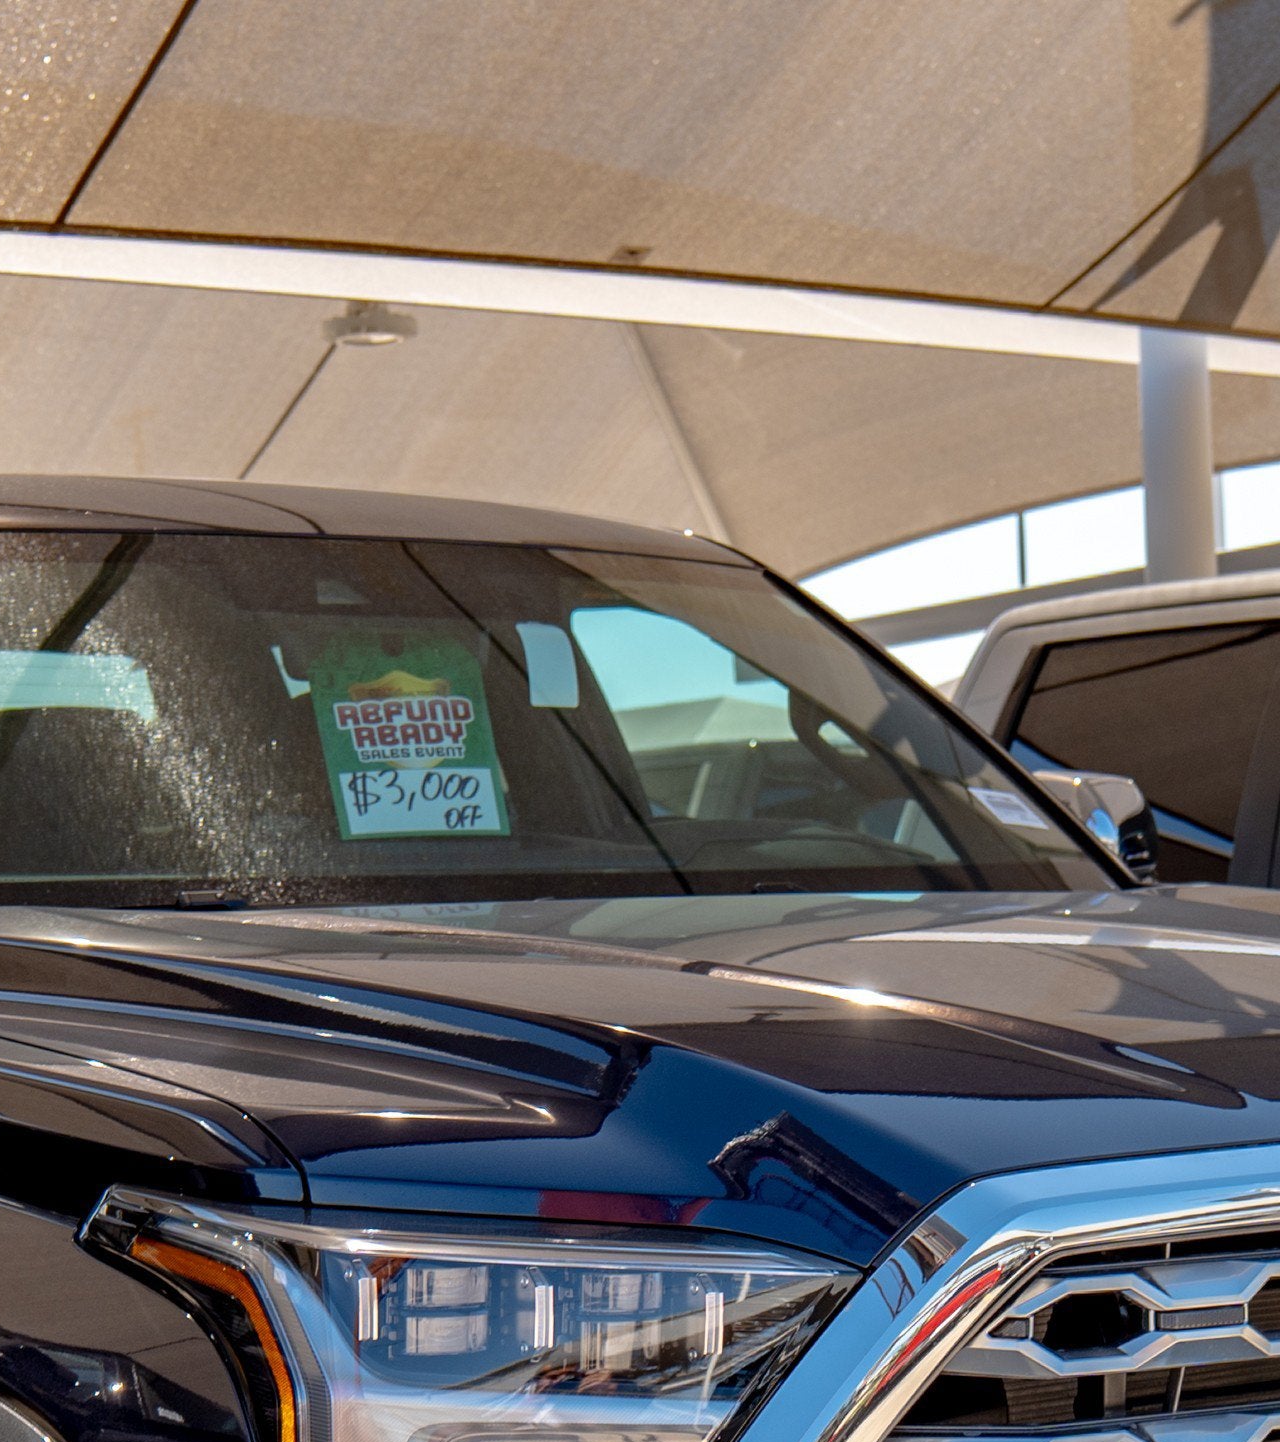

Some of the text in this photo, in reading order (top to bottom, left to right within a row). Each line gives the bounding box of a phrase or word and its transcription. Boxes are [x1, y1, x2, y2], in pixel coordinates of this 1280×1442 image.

[336, 700, 472, 727] REFUND
[354, 722, 464, 748] READY
[361, 746, 463, 761] SALES EVENT
[348, 769, 480, 817] $3,000
[444, 804, 483, 830] OFF
